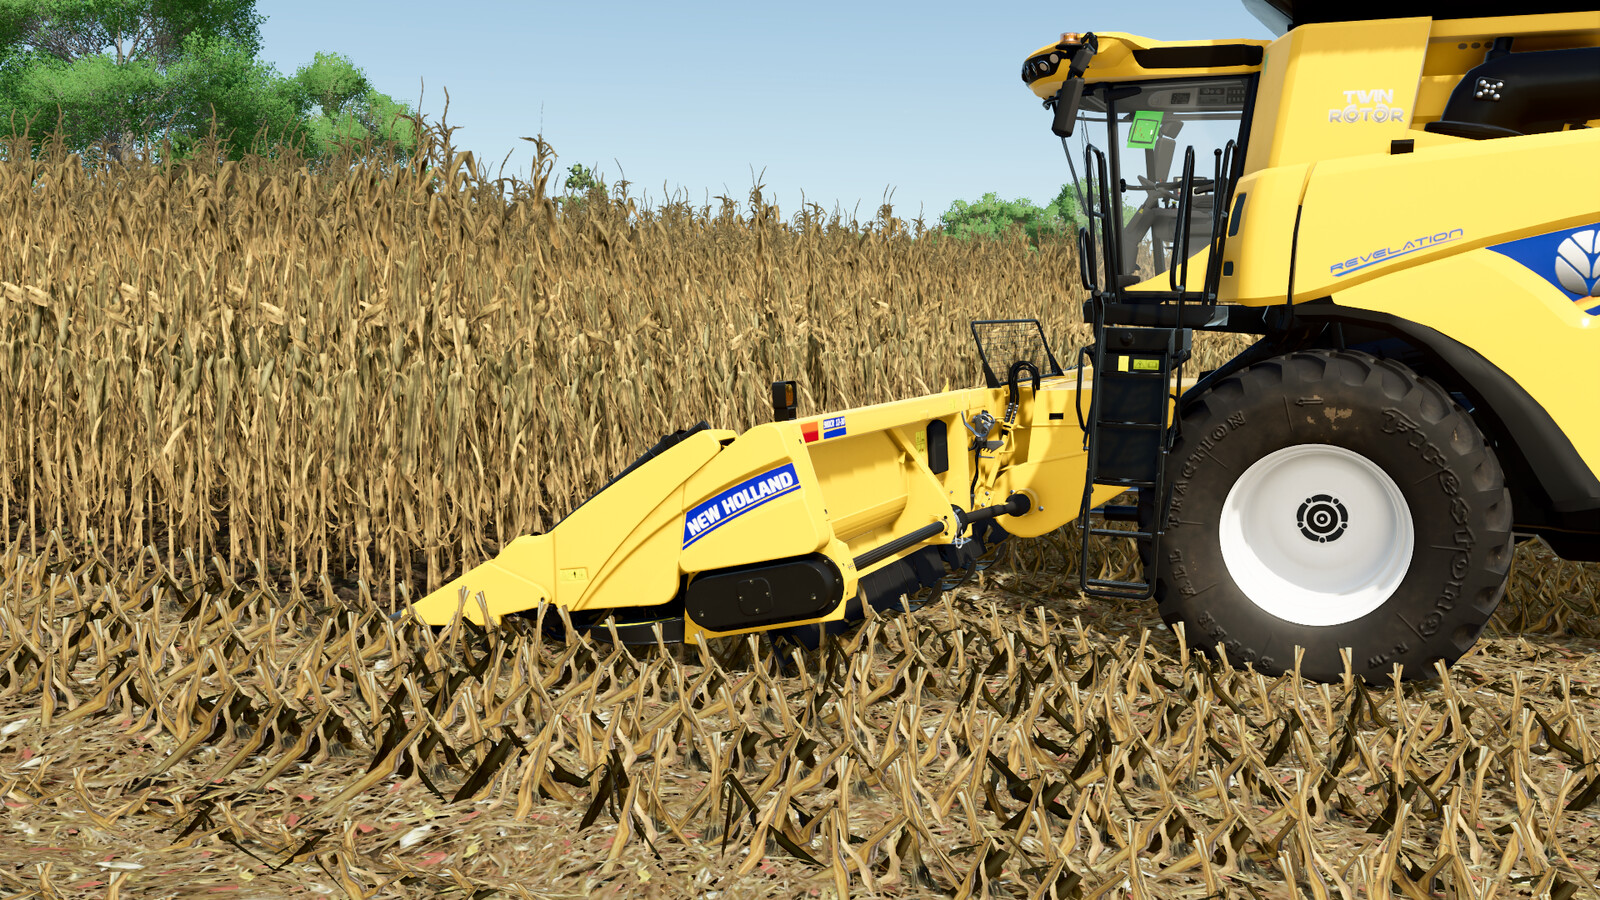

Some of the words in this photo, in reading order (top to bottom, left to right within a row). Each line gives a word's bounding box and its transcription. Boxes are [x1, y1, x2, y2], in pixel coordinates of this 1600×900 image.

[1328, 103, 1405, 124] ROTOR
[1343, 89, 1394, 104] TWIN
[1330, 228, 1464, 273] REVELATION
[1167, 410, 1247, 528] TRACTION
[686, 504, 721, 536] NEW
[721, 471, 794, 515] HOLLAND
[1381, 407, 1476, 636] Firestone
